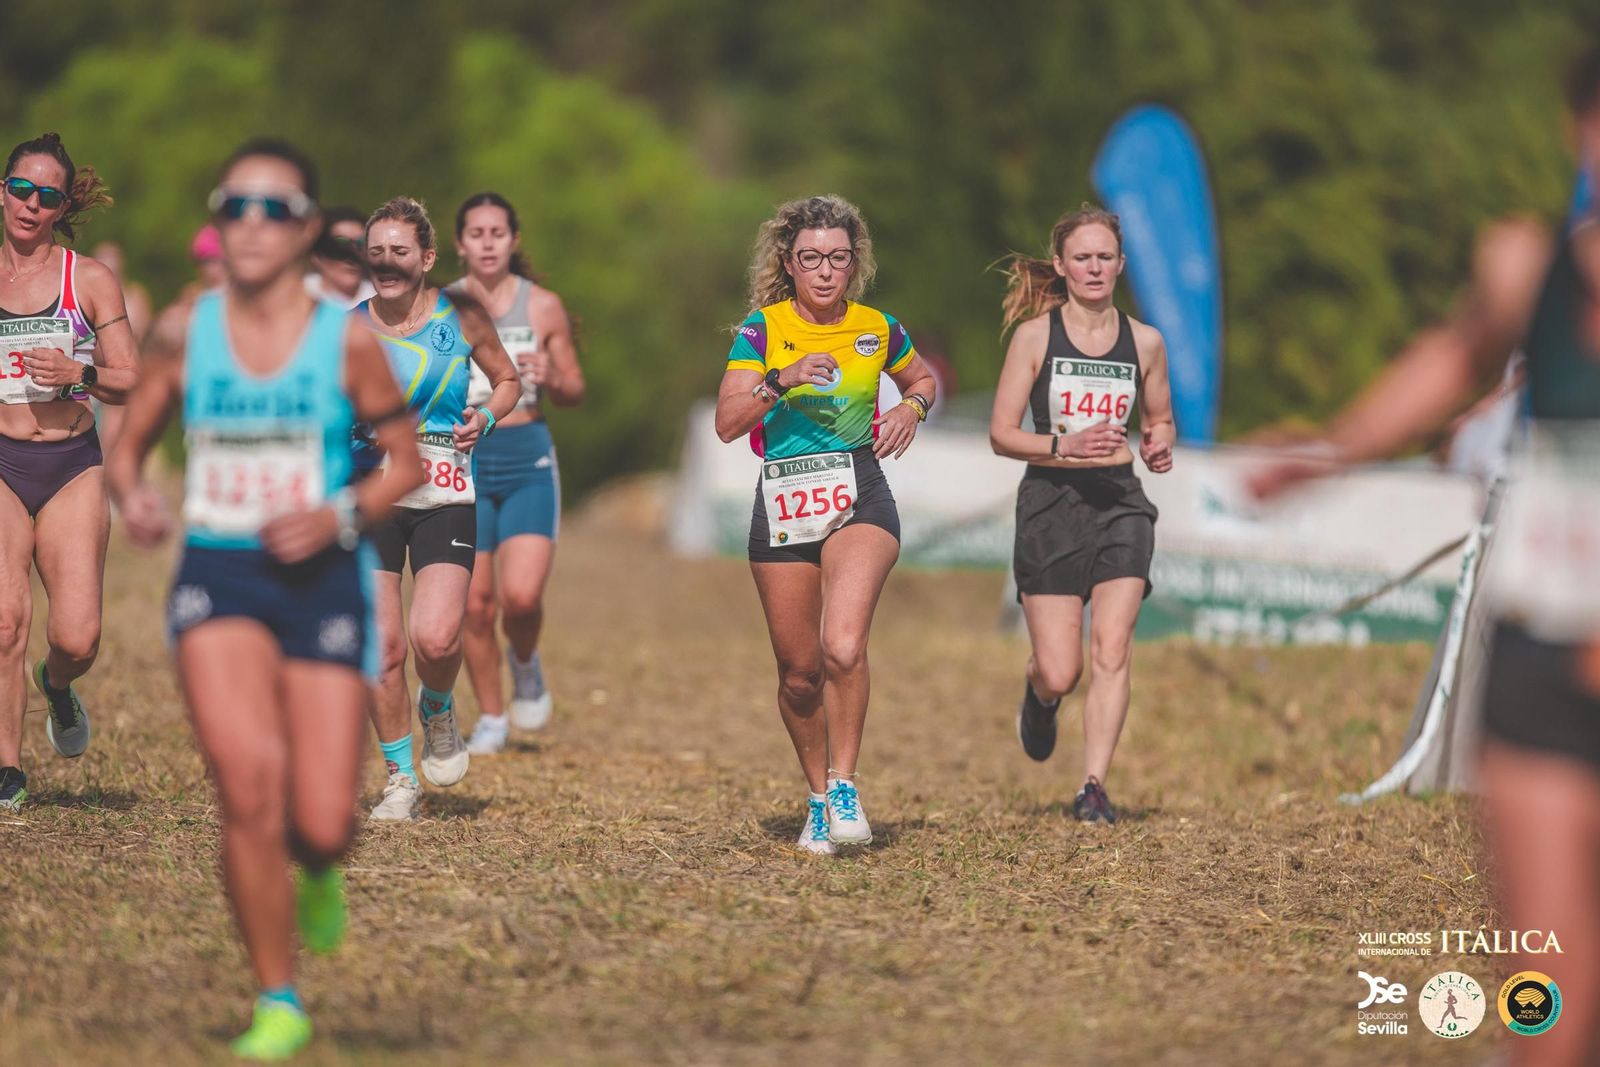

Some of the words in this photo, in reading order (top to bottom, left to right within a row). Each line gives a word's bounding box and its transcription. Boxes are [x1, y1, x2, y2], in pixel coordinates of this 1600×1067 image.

[2, 321, 46, 333] ITÁLICA
[1078, 363, 1116, 377] ITÁLICA
[800, 394, 850, 407] AireSur
[1060, 390, 1130, 420] 1446
[784, 459, 828, 474] ITÁLICA
[774, 484, 851, 521] 1256
